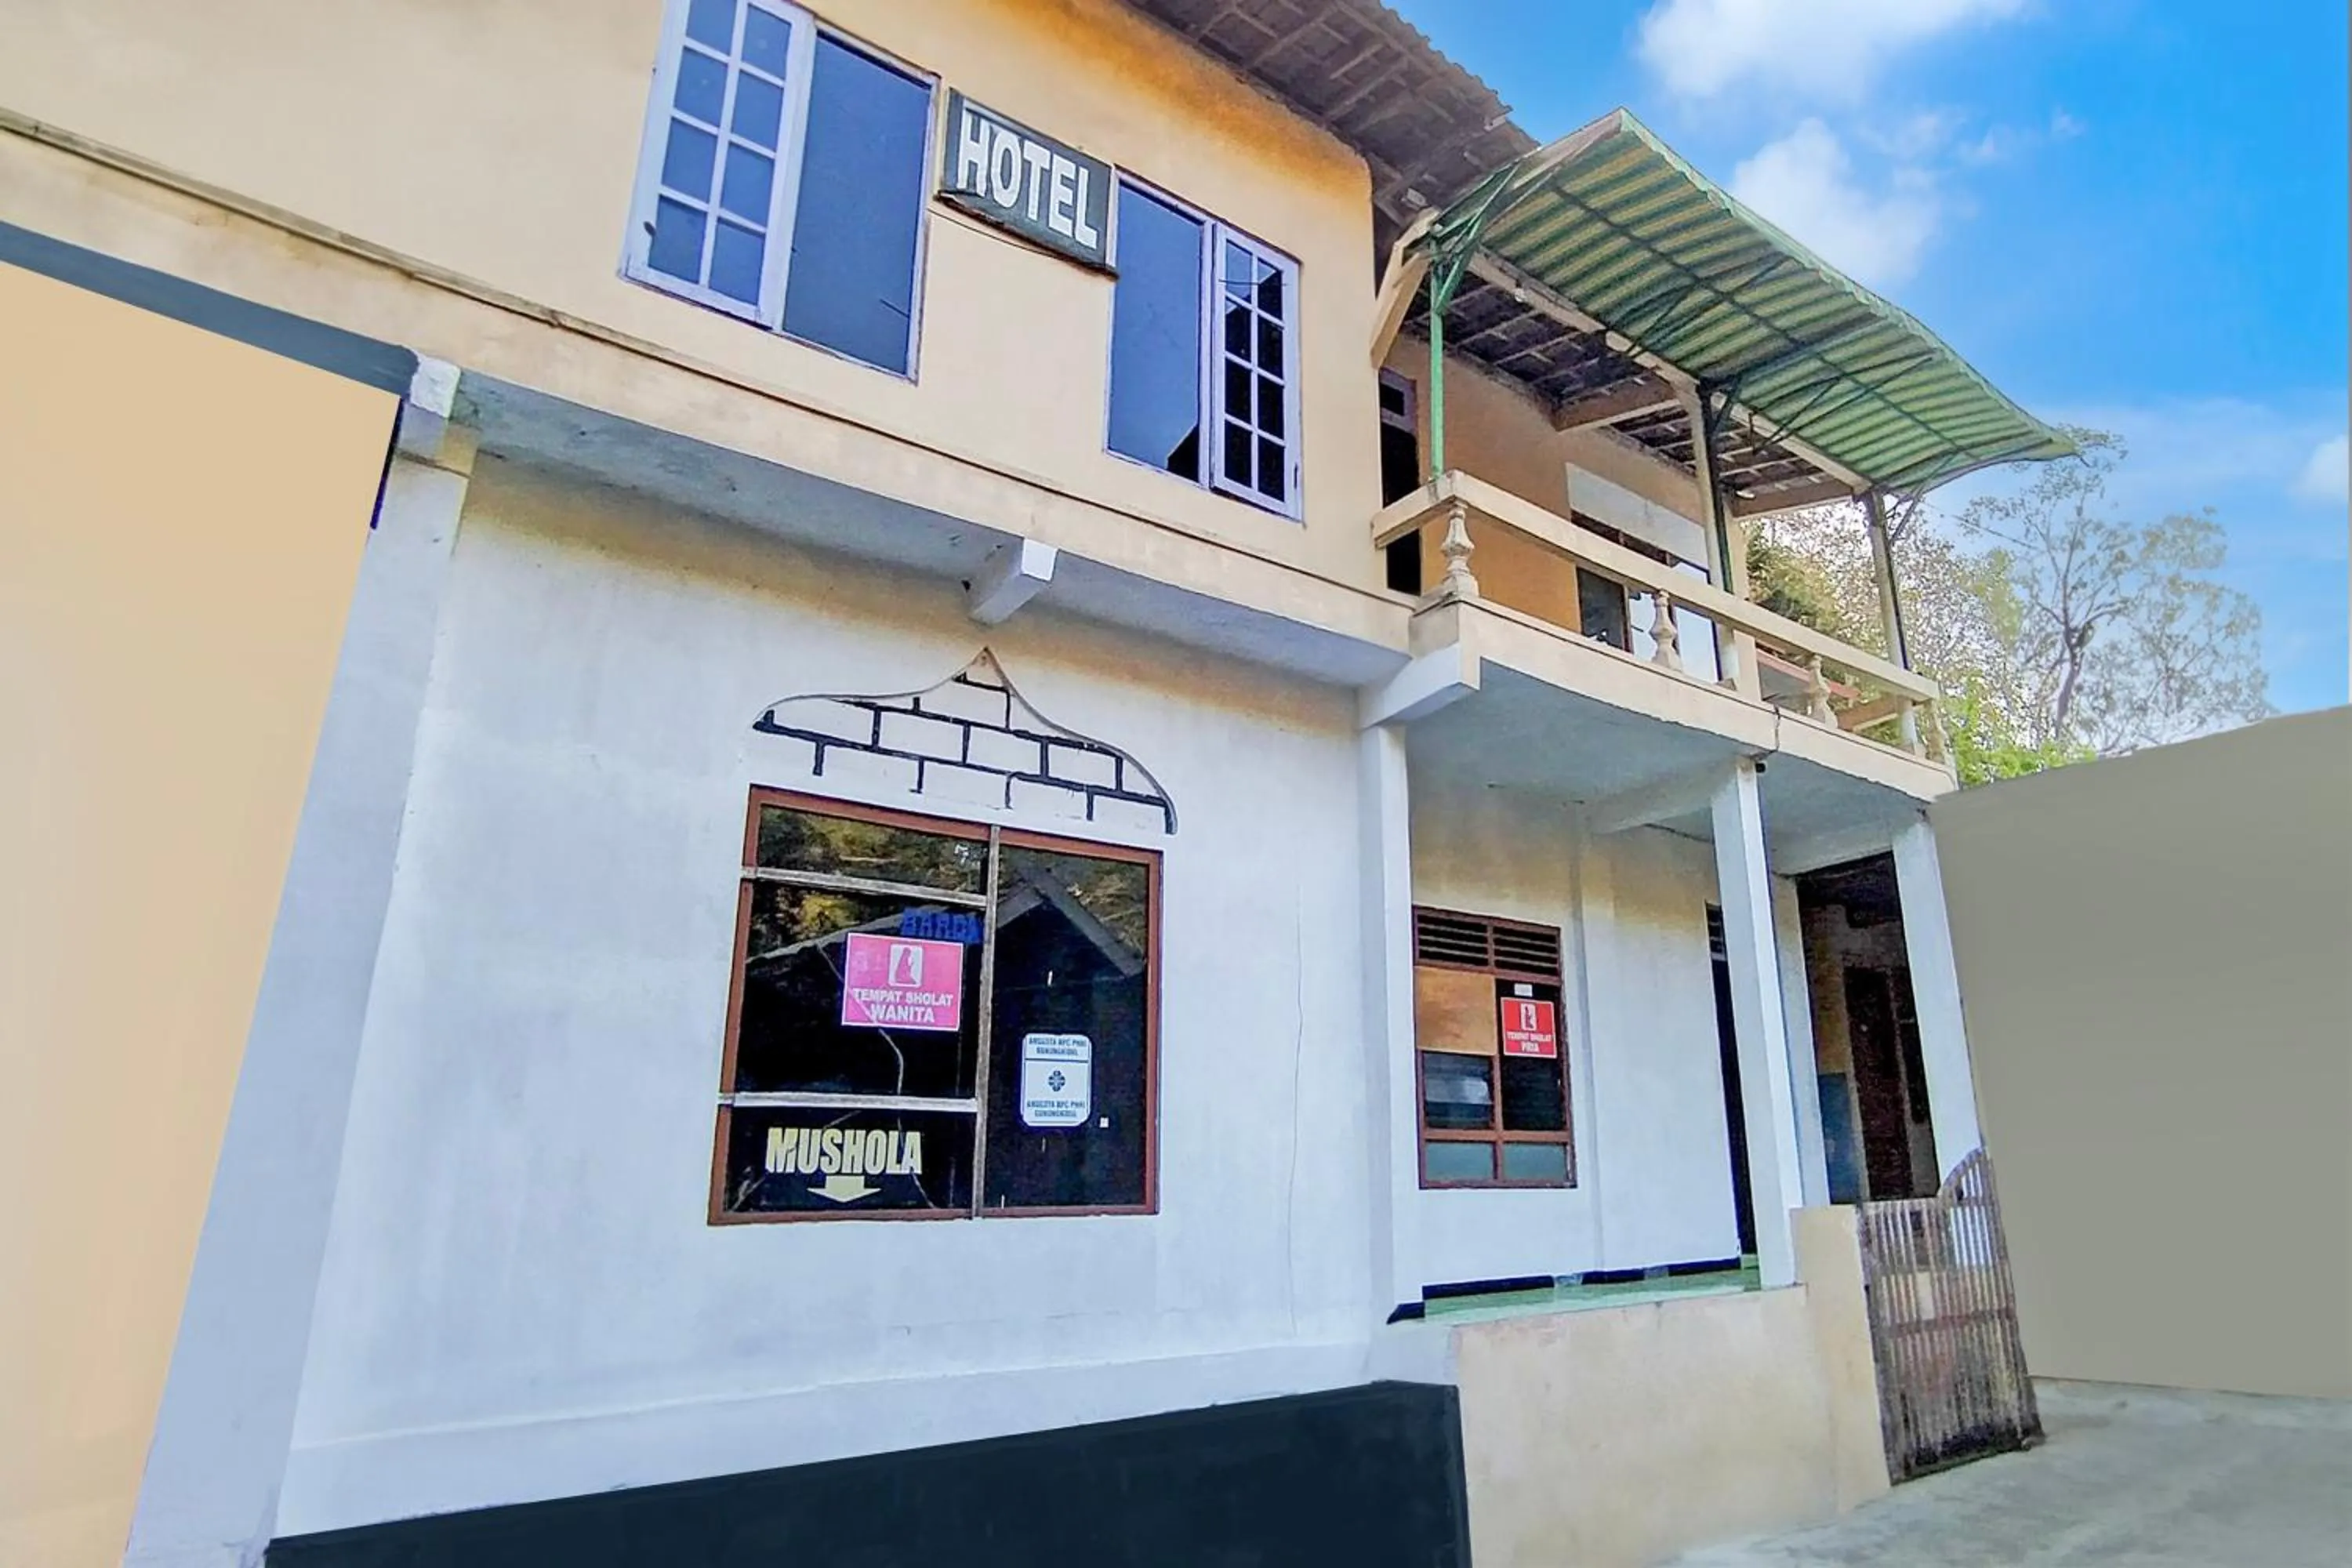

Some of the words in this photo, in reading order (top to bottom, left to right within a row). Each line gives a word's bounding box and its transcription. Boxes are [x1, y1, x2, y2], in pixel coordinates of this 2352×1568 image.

[956, 108, 1098, 249] HOTEL
[853, 988, 901, 1003] TEMPAT
[906, 993, 953, 1007] SHOLAT
[870, 1004, 935, 1023] WANITA
[765, 1127, 922, 1175] MUSHOLA
